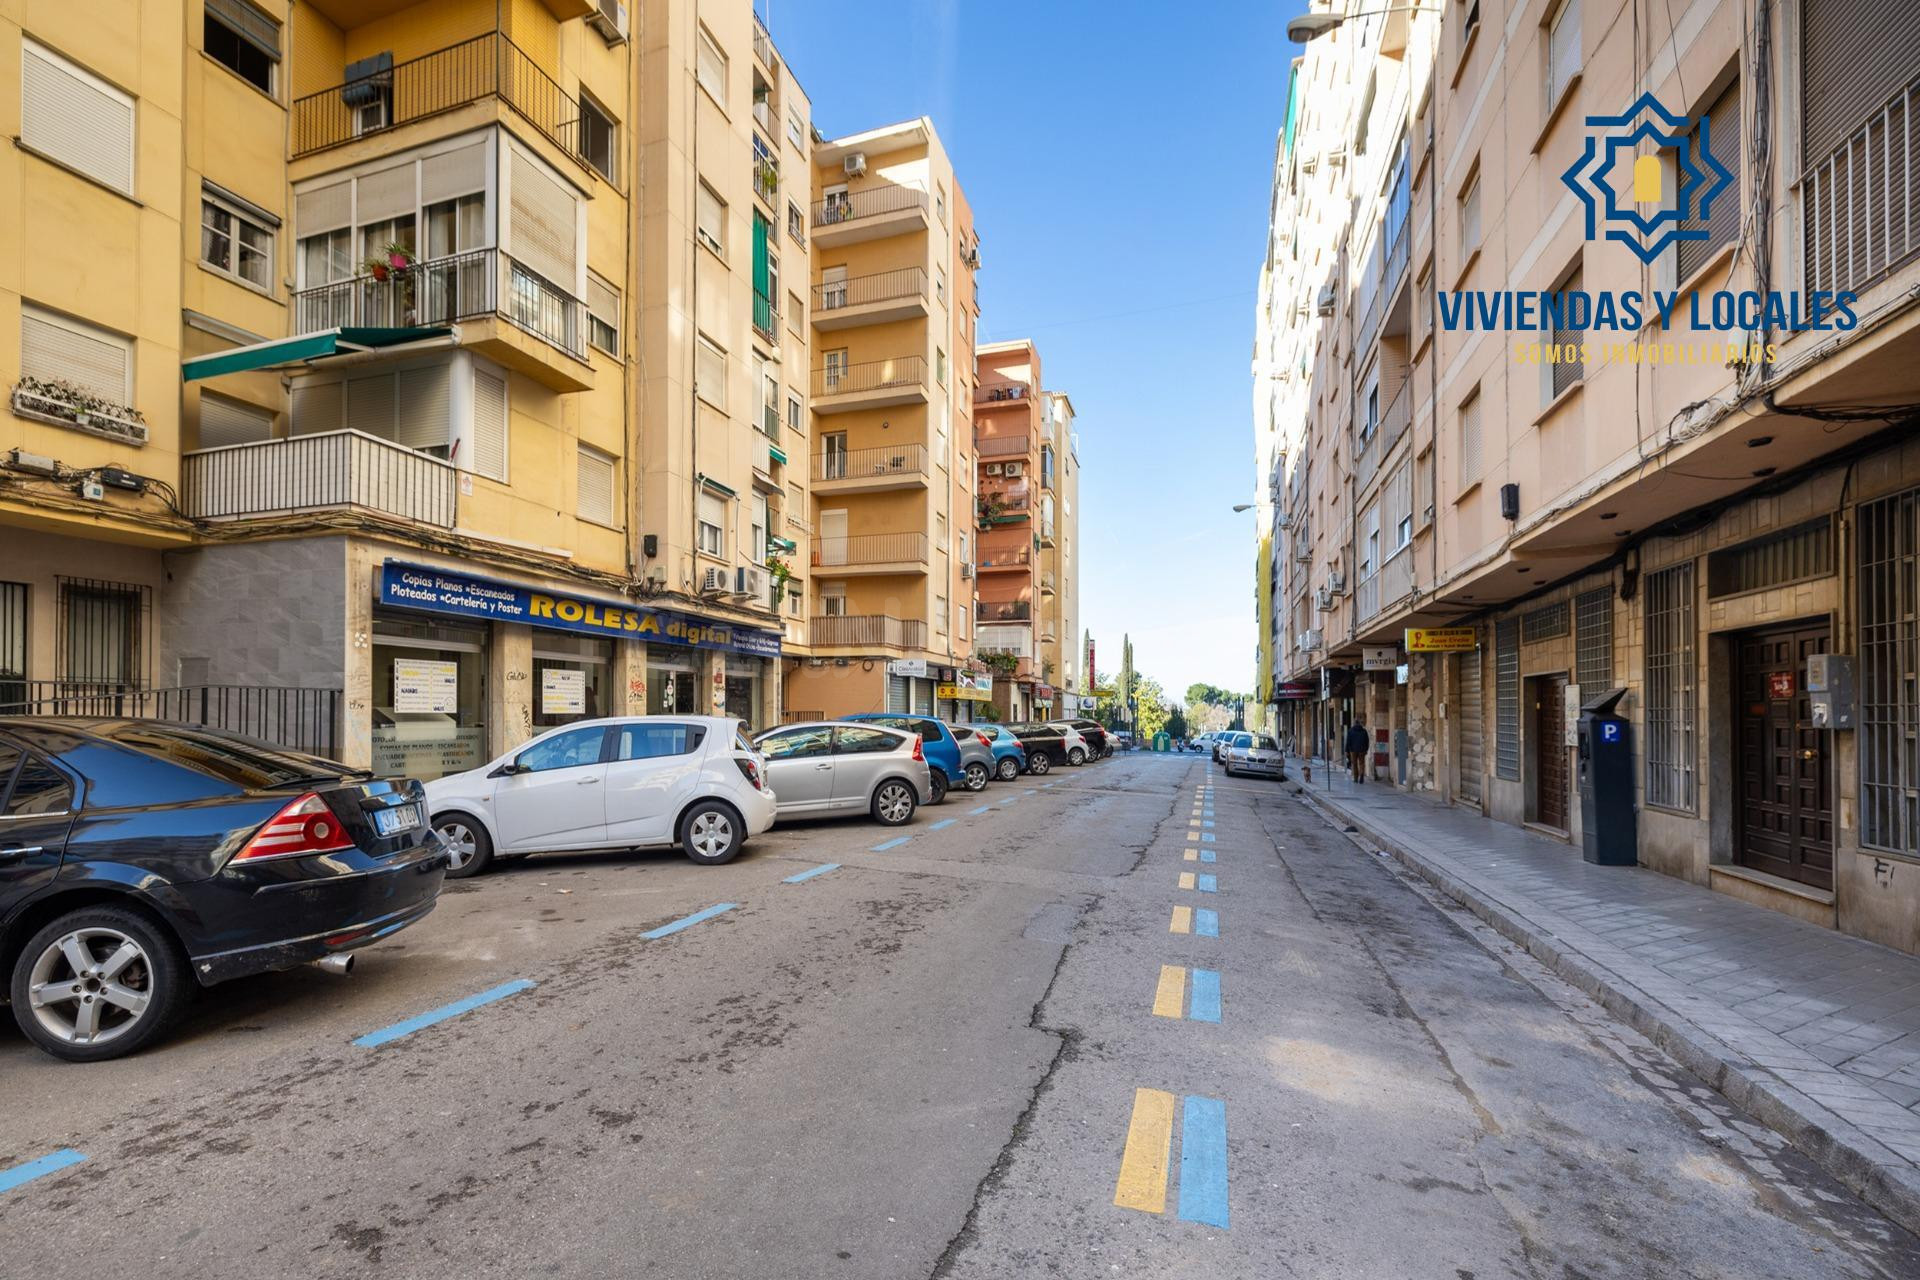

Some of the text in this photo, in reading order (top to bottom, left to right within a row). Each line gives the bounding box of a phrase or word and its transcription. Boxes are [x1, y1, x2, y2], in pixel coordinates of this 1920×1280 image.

[402, 573, 433, 588] Copias
[436, 578, 463, 592] Planos
[391, 584, 523, 615] Ploteados Cartelería y Poster
[529, 594, 660, 634] ROLESA
[666, 621, 732, 644] digital
[1604, 724, 1617, 739] P
